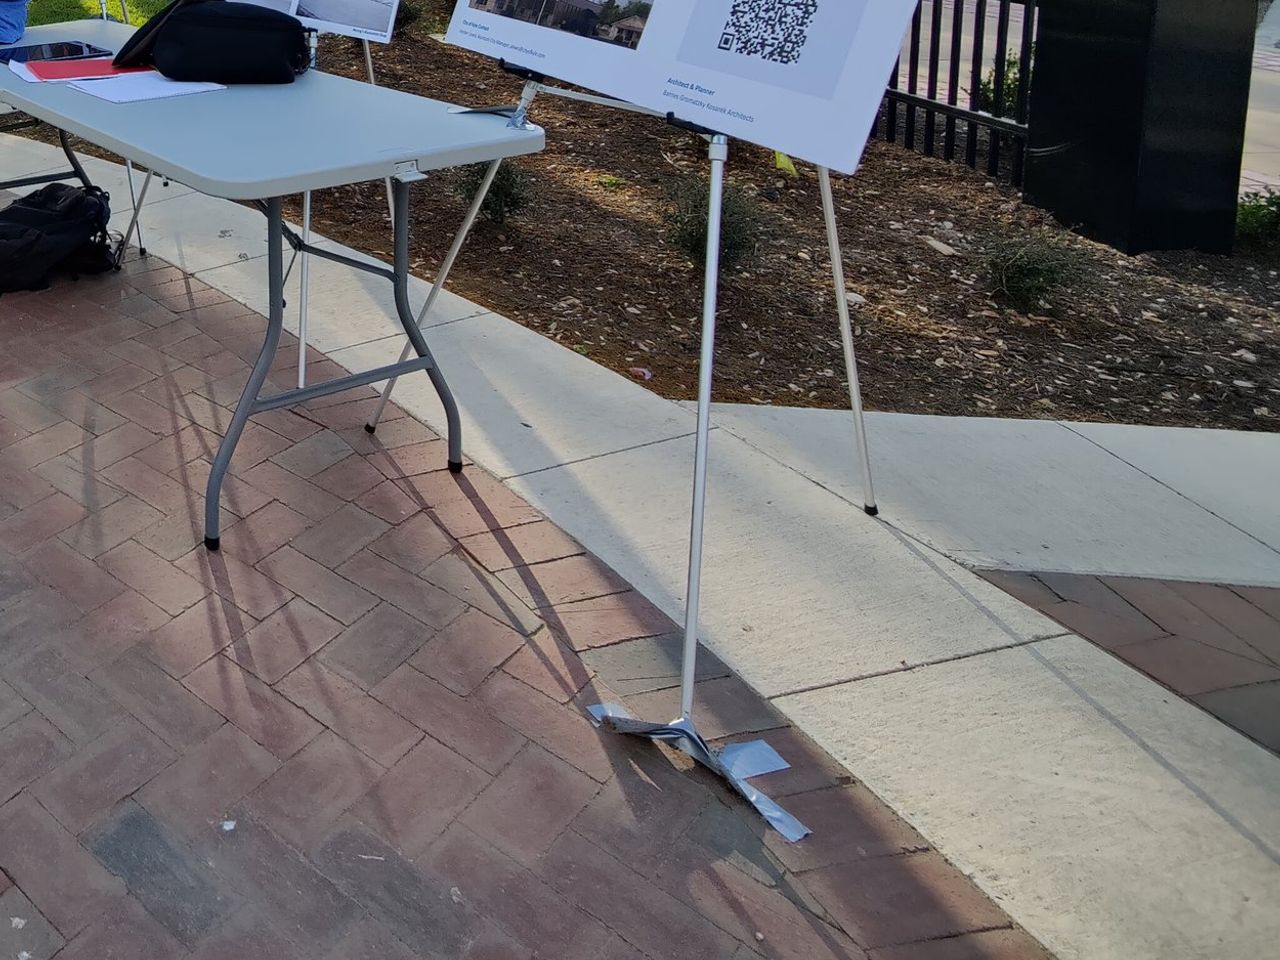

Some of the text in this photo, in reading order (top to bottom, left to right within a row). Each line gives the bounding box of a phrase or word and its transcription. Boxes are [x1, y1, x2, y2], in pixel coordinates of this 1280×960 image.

[667, 78, 690, 89] Architect
[695, 85, 715, 96] Planner
[727, 109, 754, 123] Architects
